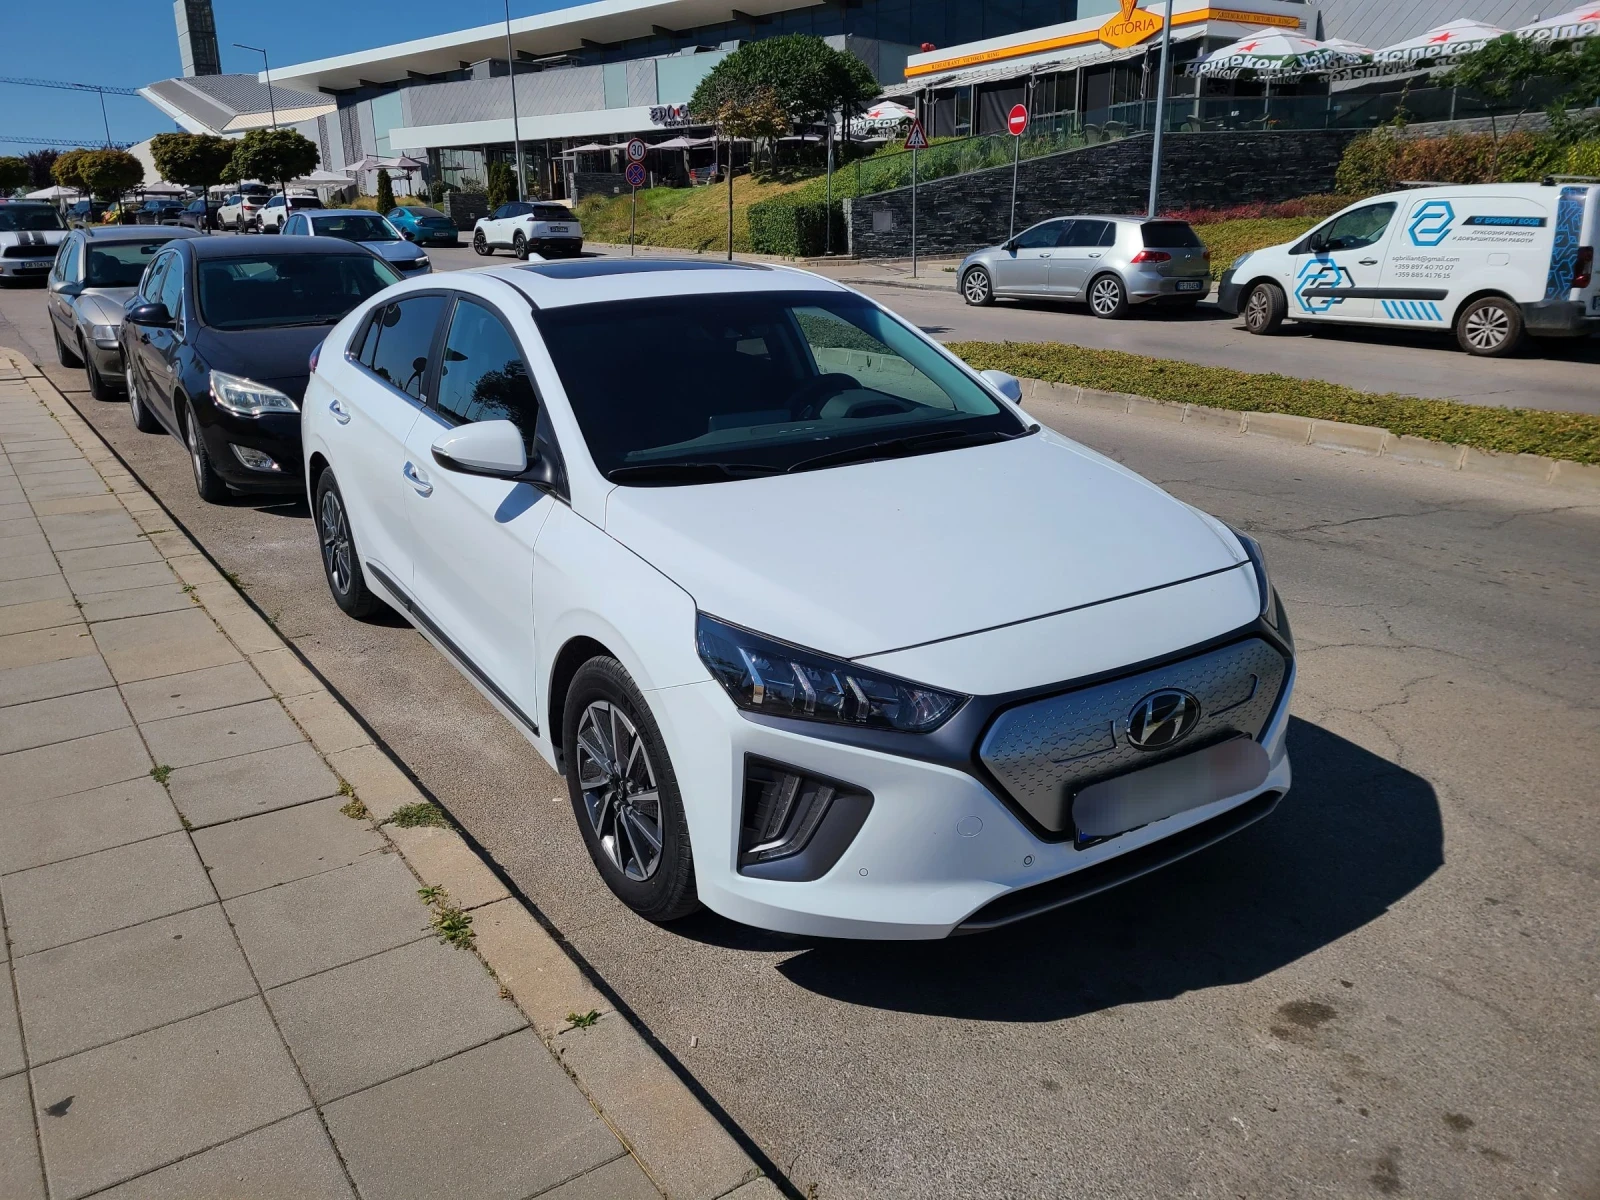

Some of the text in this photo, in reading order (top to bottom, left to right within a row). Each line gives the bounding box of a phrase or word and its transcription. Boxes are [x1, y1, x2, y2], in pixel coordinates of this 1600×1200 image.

[1217, 11, 1250, 19] RESTAURANT
[1254, 14, 1276, 23] VICTORIA
[1105, 18, 1155, 37] VICTORIA
[1515, 22, 1600, 43] Heine
[1374, 40, 1486, 62] Heineken
[931, 60, 960, 70] RESTAURANT
[963, 54, 985, 63] VICTORIA
[1184, 55, 1283, 78] Heineken
[631, 144, 643, 156] 30
[1484, 217, 1517, 225] БРИЛЯНТ
[1518, 218, 1540, 226] ЕООД
